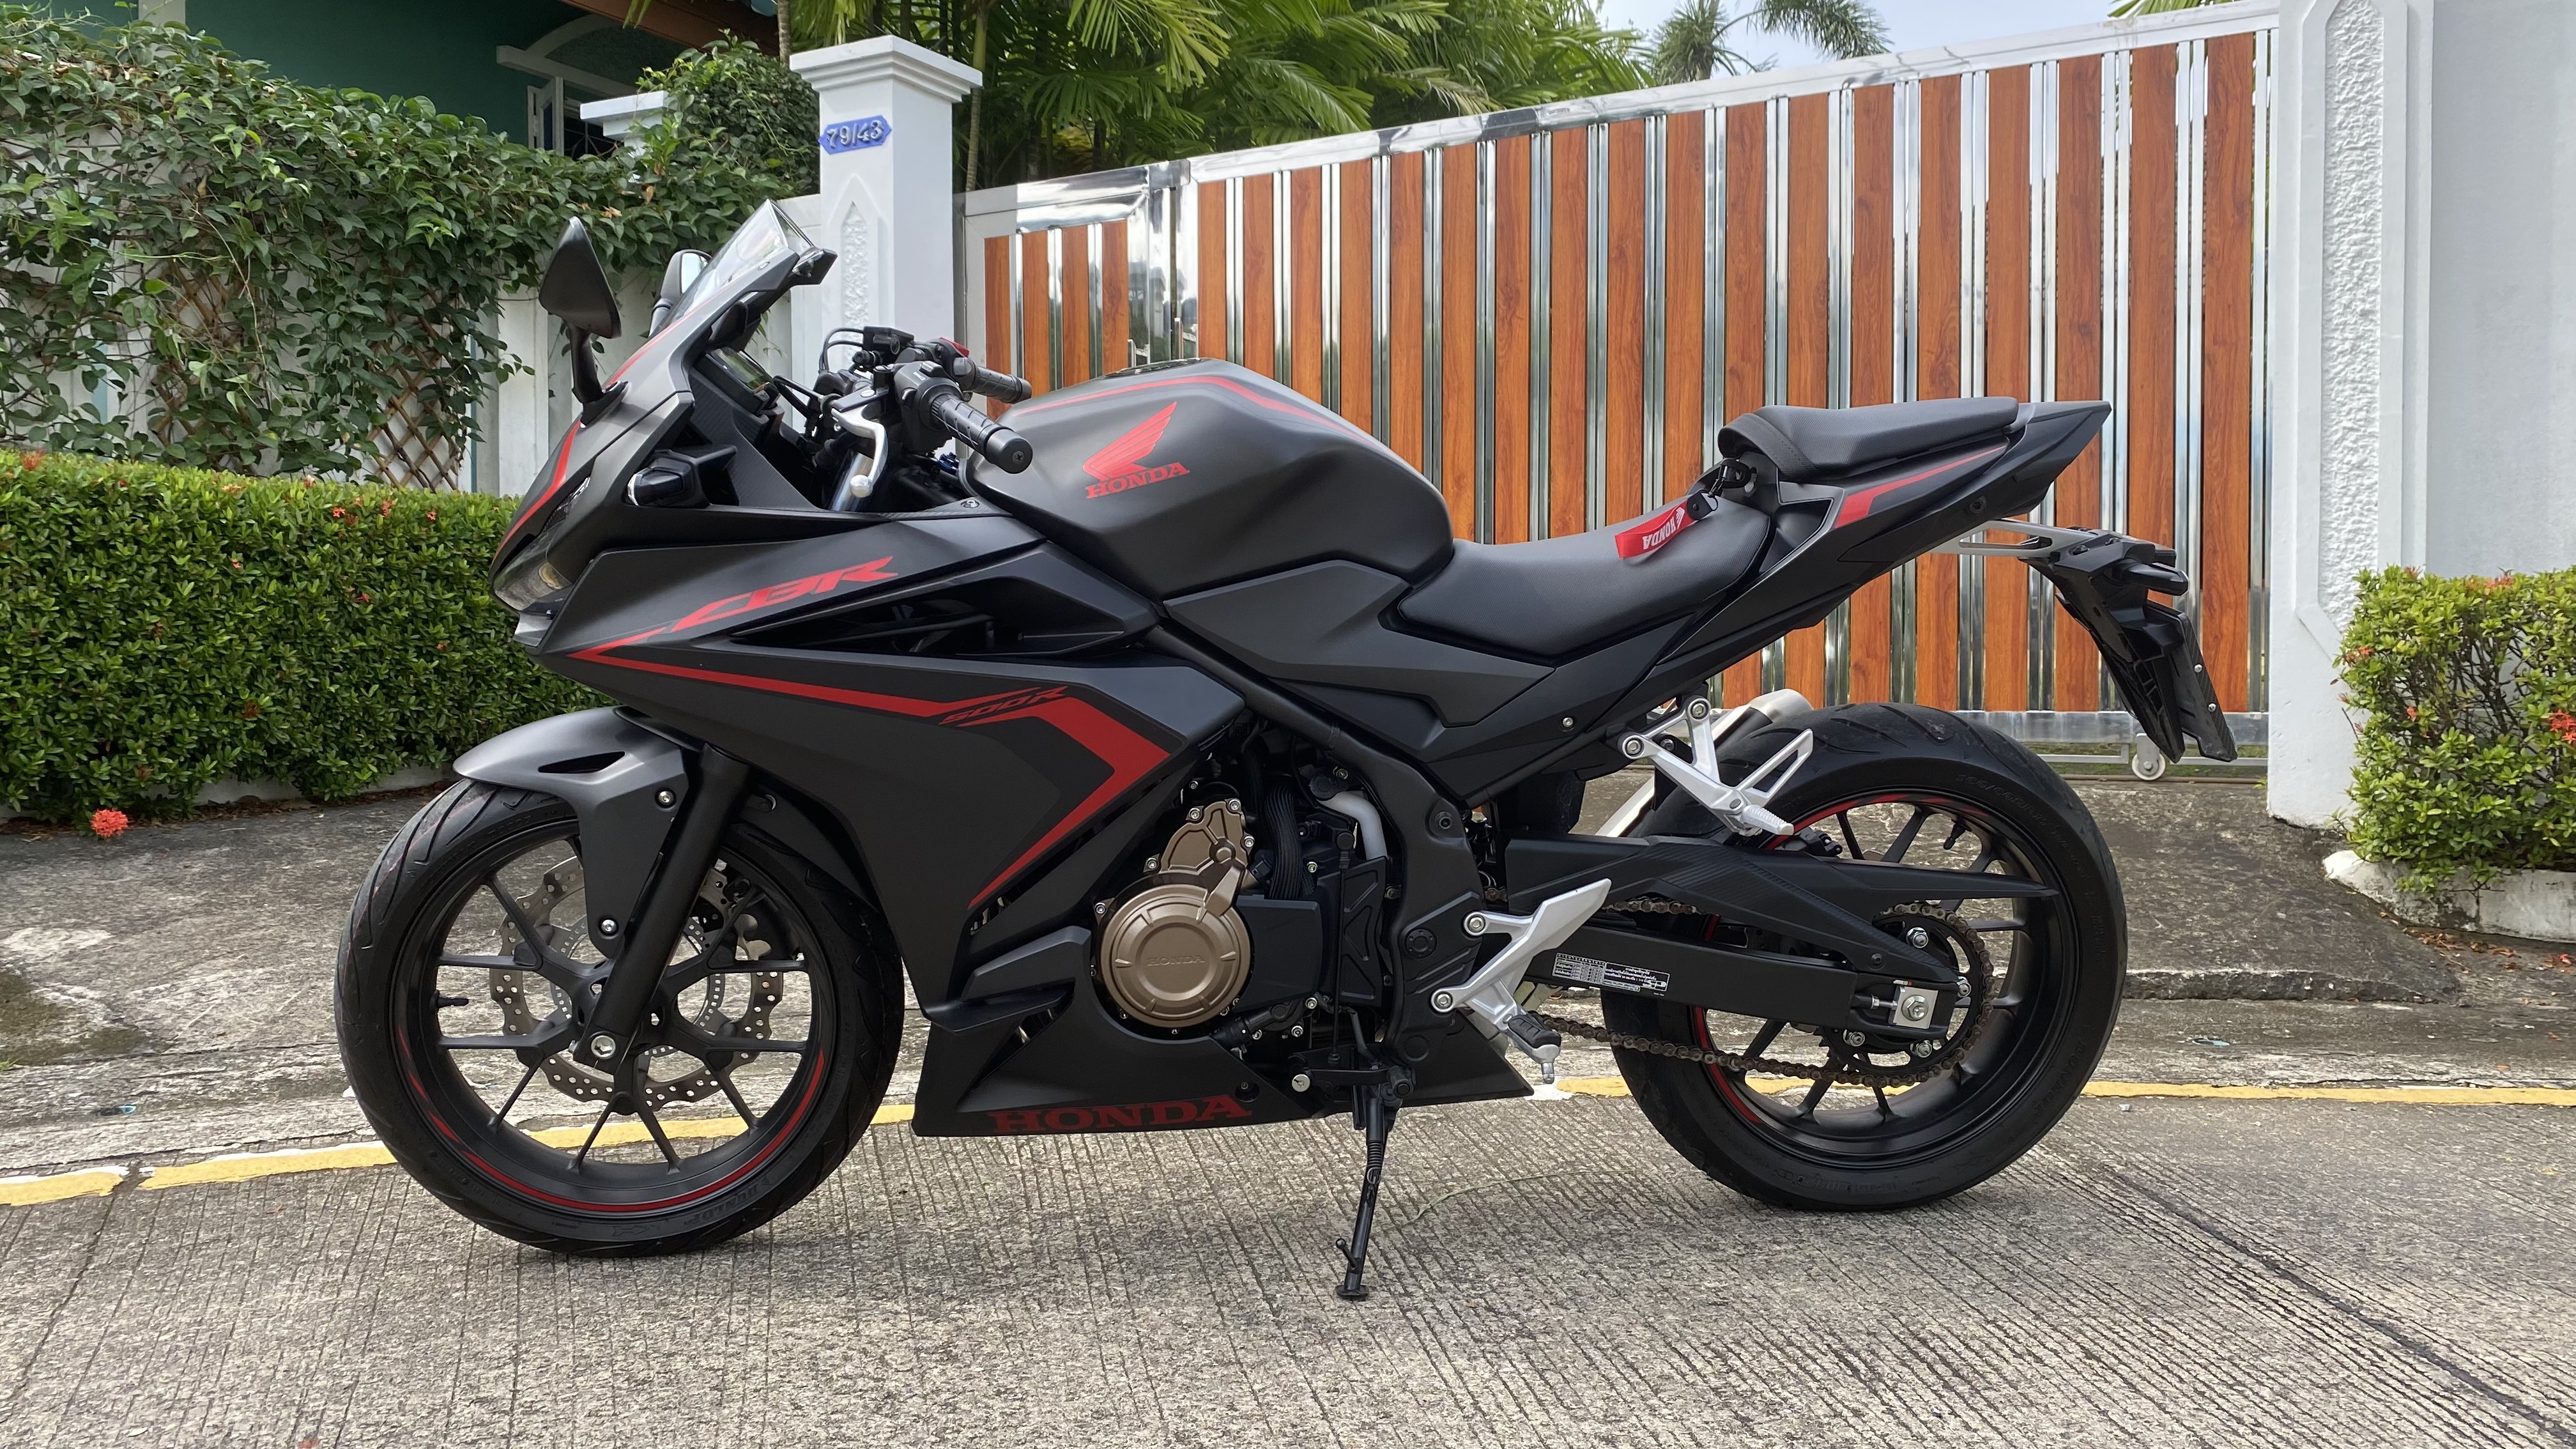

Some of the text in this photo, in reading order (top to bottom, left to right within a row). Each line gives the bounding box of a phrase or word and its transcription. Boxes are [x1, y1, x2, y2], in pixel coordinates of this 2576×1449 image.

[826, 119, 884, 150] 79/43
[1085, 461, 1190, 499] HONDA
[1642, 516, 1677, 550] HONDA
[670, 555, 898, 632] CBR
[987, 1094, 1252, 1133] HONDA
